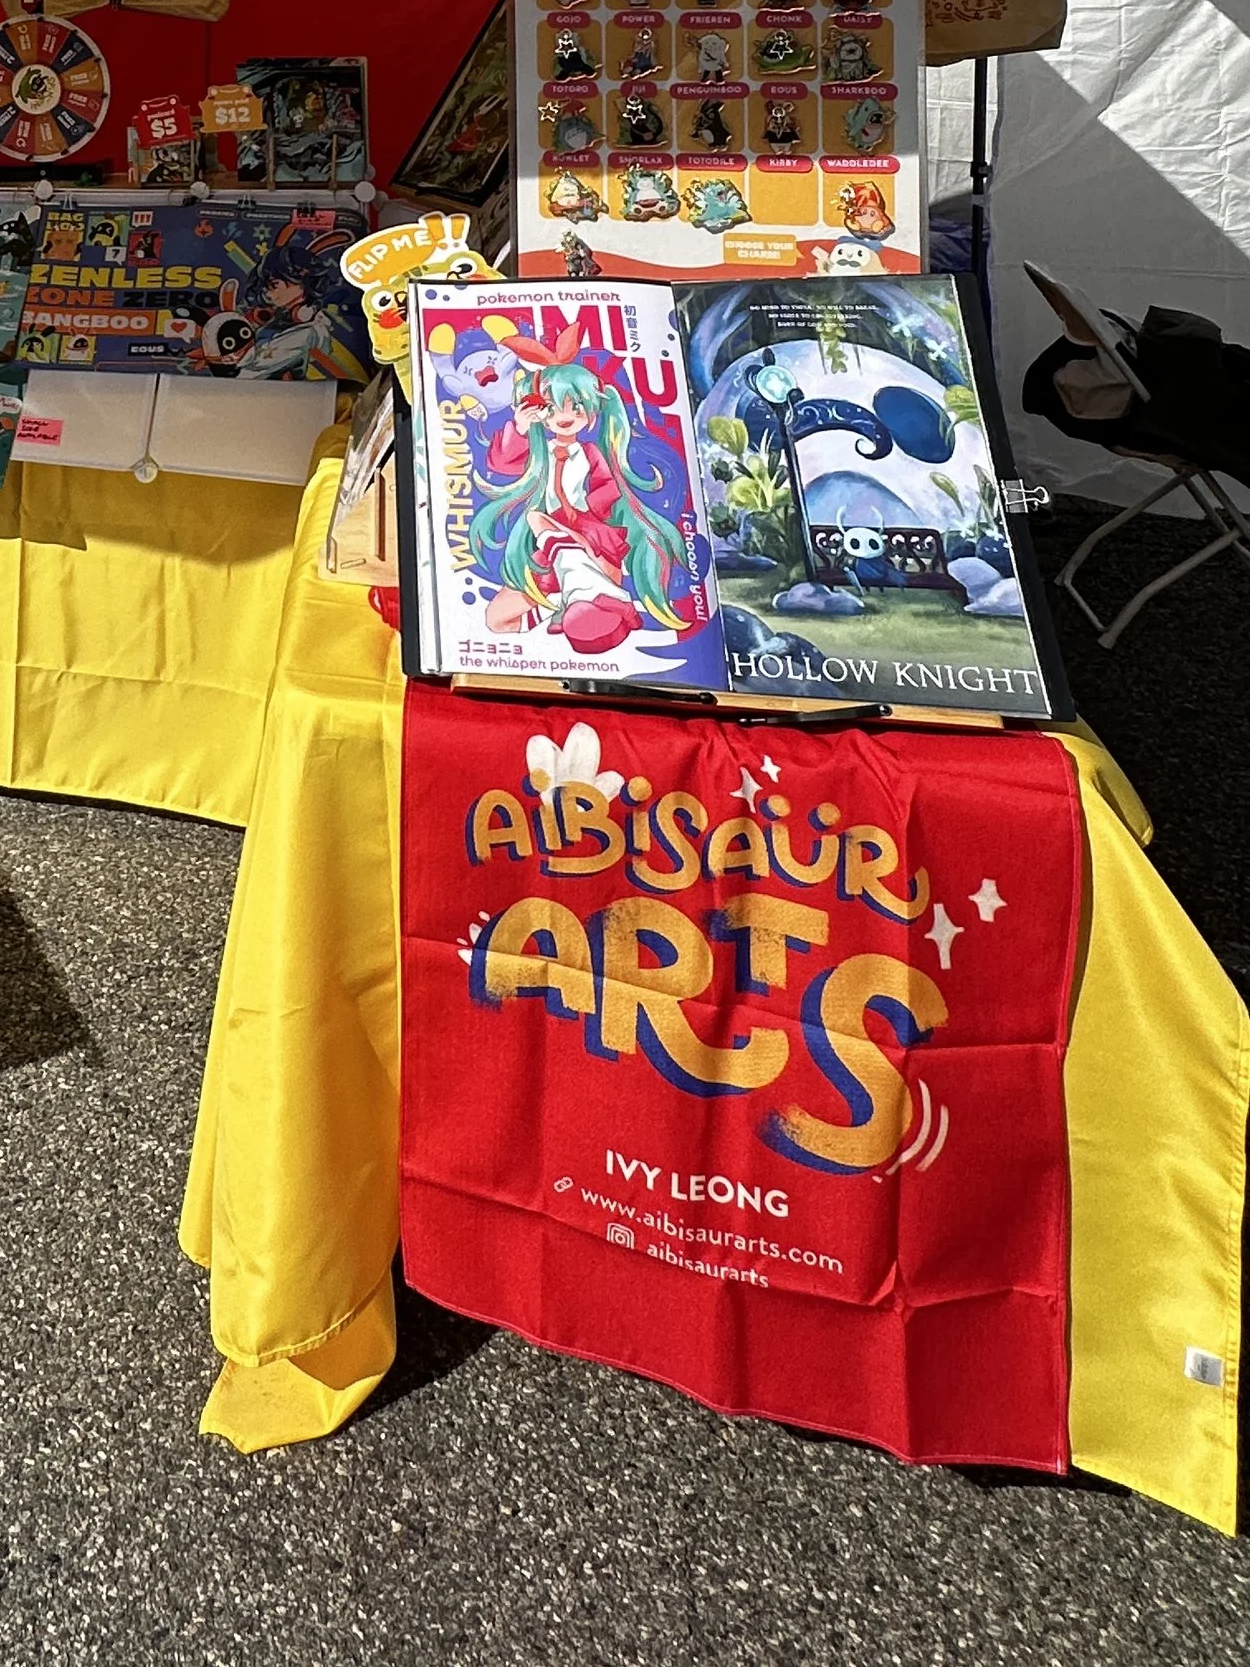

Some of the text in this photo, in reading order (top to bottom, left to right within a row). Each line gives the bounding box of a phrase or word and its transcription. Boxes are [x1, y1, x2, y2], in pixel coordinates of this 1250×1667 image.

[556, 15, 581, 24] GOJO
[622, 15, 655, 24] POWER
[690, 15, 731, 24] FRIEREN
[766, 15, 802, 24] CHONK
[552, 85, 588, 94] TOTORO
[831, 85, 886, 95] SHARKBOO
[215, 107, 250, 124] $12
[150, 118, 178, 139] $5
[688, 157, 734, 166] TOTODILE
[349, 243, 388, 280] FLIP
[31, 265, 222, 288] ZENLESS
[123, 290, 218, 308] ZERO
[476, 289, 621, 306] pokemon trainer
[22, 310, 149, 330] BANGBOO
[541, 305, 627, 351] MI
[623, 304, 643, 352] 初音ミク
[440, 399, 473, 573] WHISMUR
[690, 583, 708, 622] you!
[459, 656, 620, 676] the whisper pokemon
[733, 651, 1038, 695] HOLLOW KNIGHT
[468, 892, 950, 1176] ARTS
[605, 1149, 791, 1218] IVY LEONG
[580, 1184, 845, 1276] www.aibisaurarts.com
[645, 1240, 771, 1289] aibisaurarts
